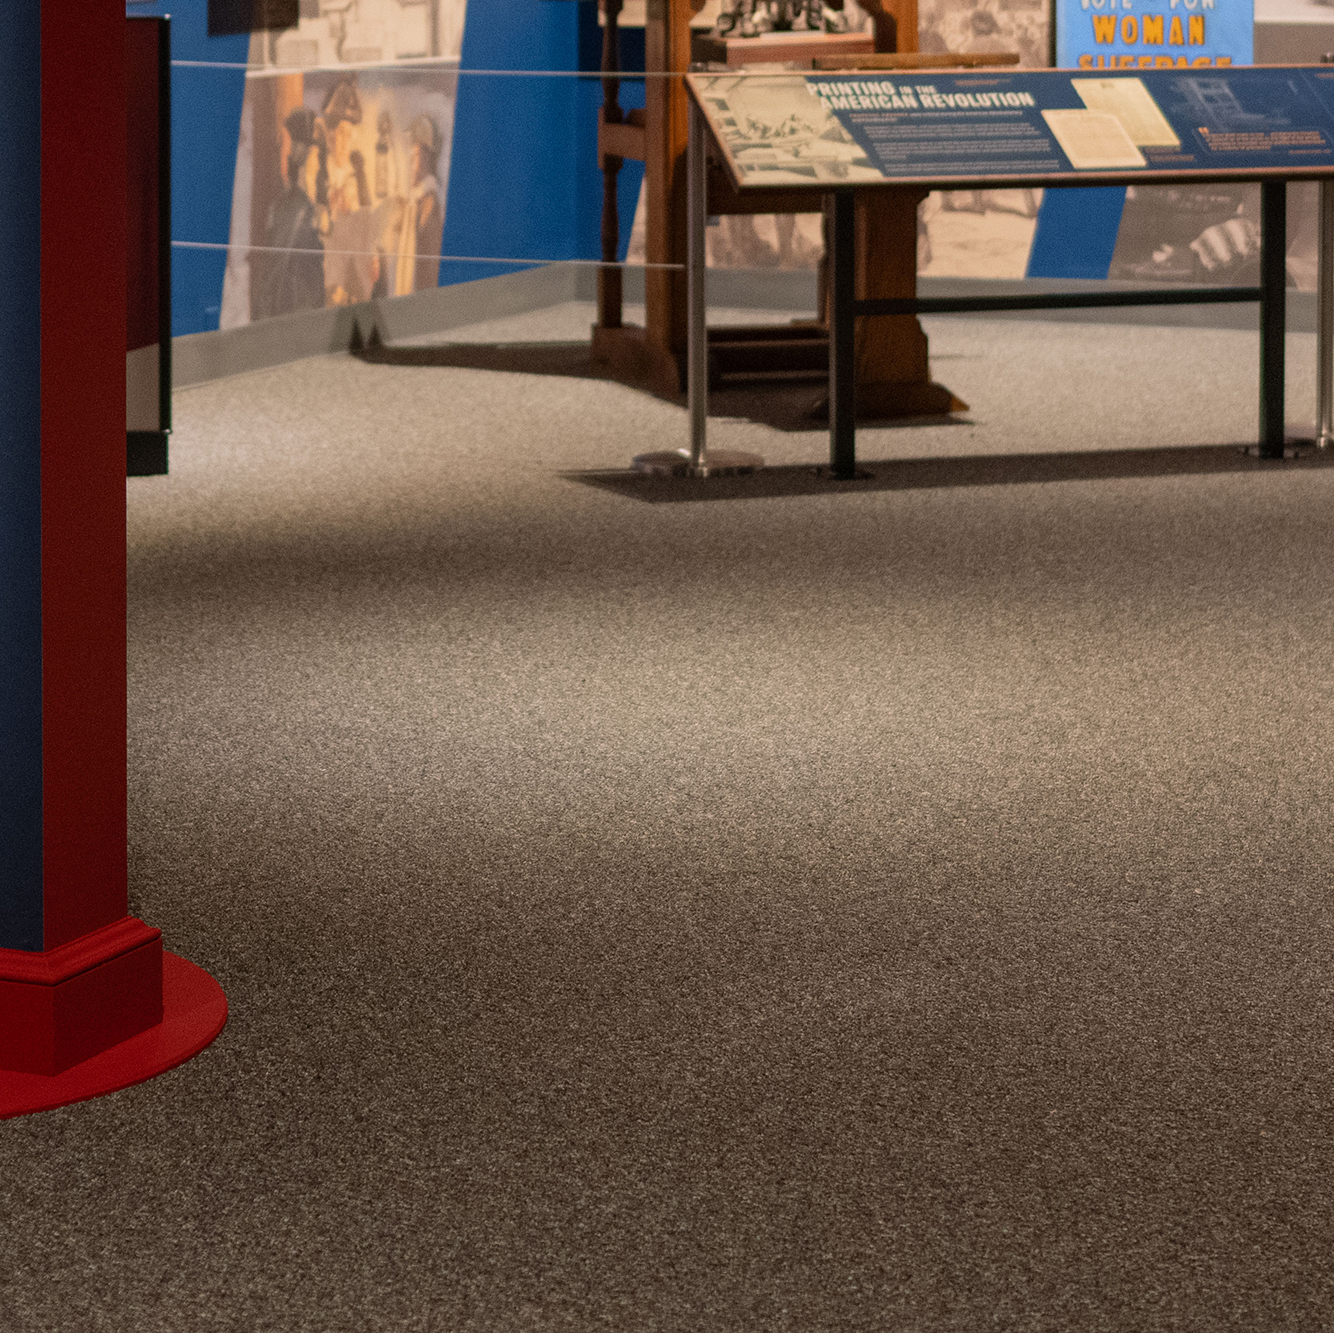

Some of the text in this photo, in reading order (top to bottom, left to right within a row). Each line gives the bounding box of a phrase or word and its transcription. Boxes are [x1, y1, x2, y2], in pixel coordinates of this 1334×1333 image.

[1092, 15, 1205, 45] WOMAN
[807, 81, 896, 97] PRINTING
[915, 85, 938, 95] THE
[818, 91, 1035, 111] AMERICAN REVOLUTION
